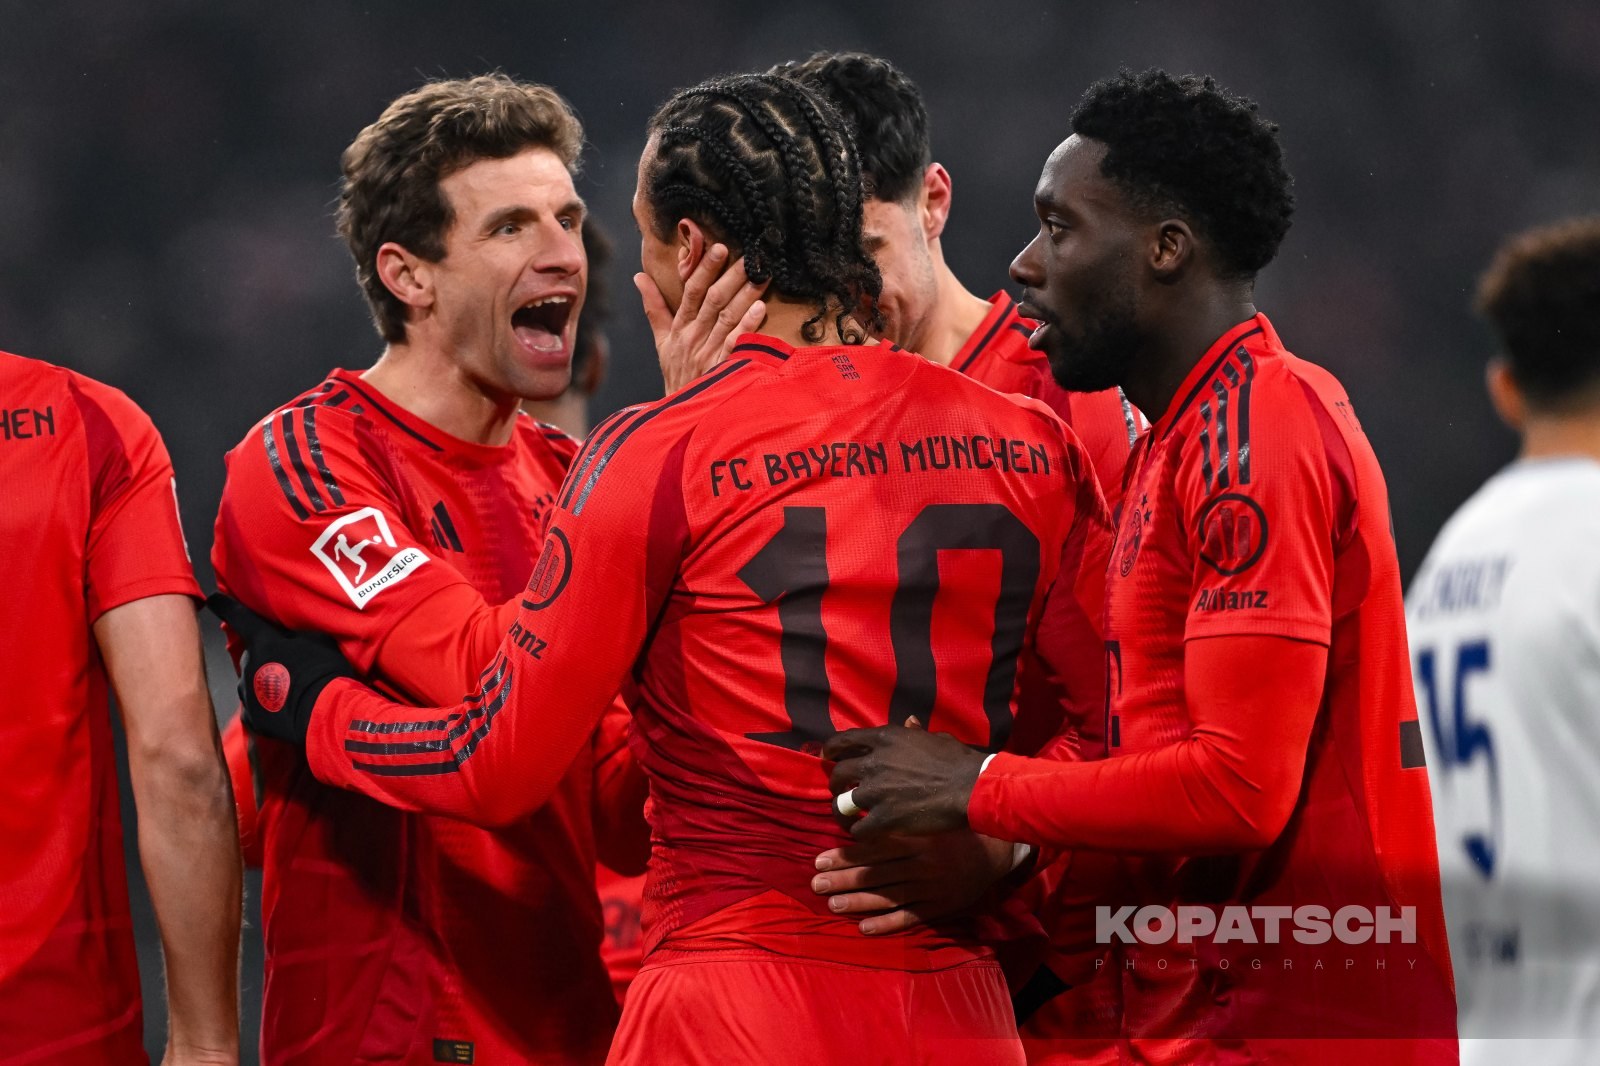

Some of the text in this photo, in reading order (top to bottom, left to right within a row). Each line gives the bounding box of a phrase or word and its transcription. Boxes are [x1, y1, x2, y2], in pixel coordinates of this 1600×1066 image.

[710, 435, 1050, 497] FC BAYERN MÜNCHEN
[357, 552, 419, 598] BUNDESLIGA
[1195, 587, 1268, 612] Allianz
[735, 503, 1041, 755] 10
